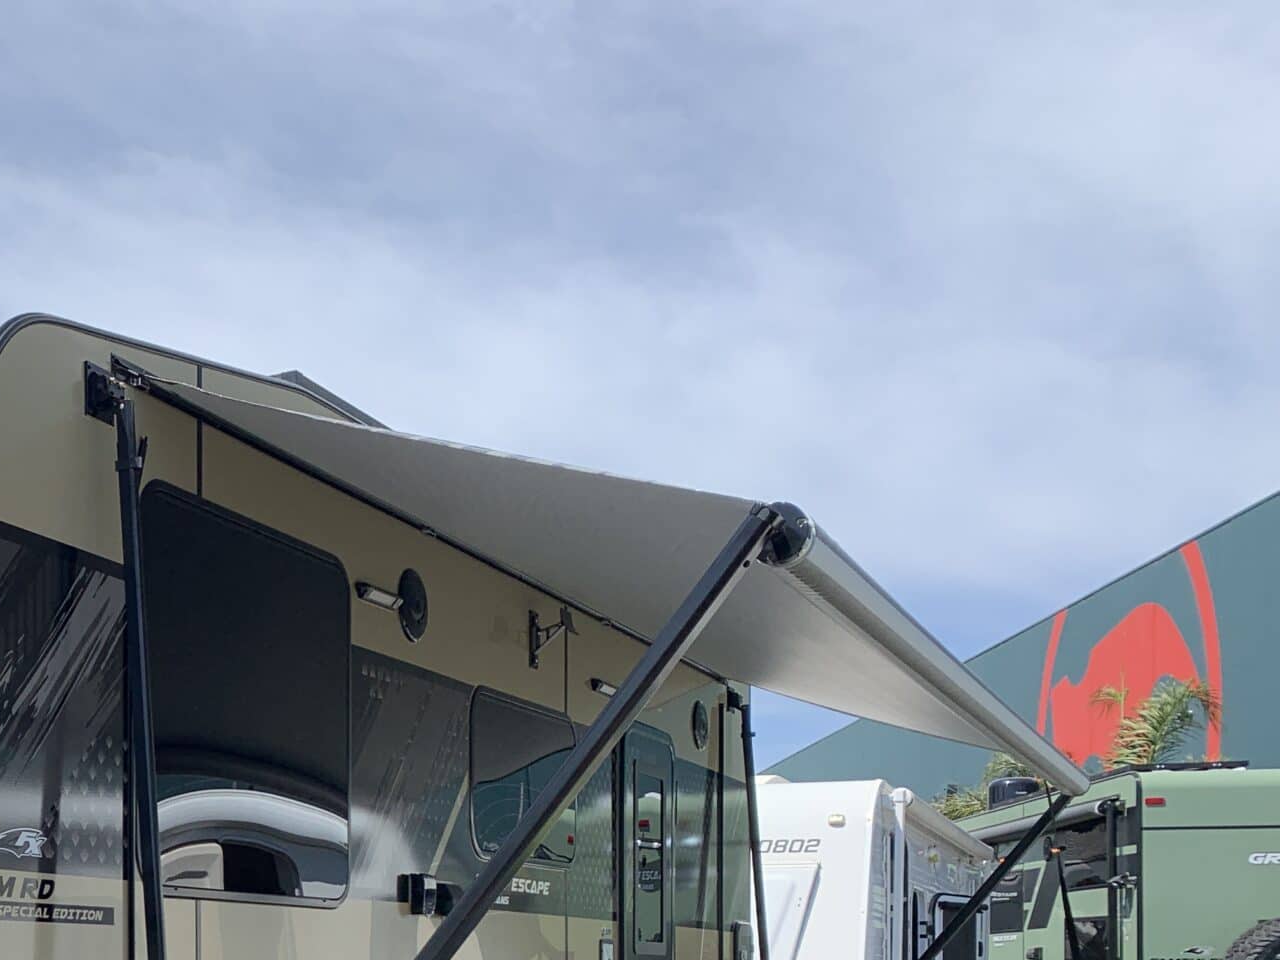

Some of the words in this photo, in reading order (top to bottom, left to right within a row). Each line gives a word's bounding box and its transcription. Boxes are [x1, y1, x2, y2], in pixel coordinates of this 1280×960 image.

[19, 878, 56, 900] RD
[511, 877, 551, 896] ESCAPE
[52, 907, 104, 921] EDITION
